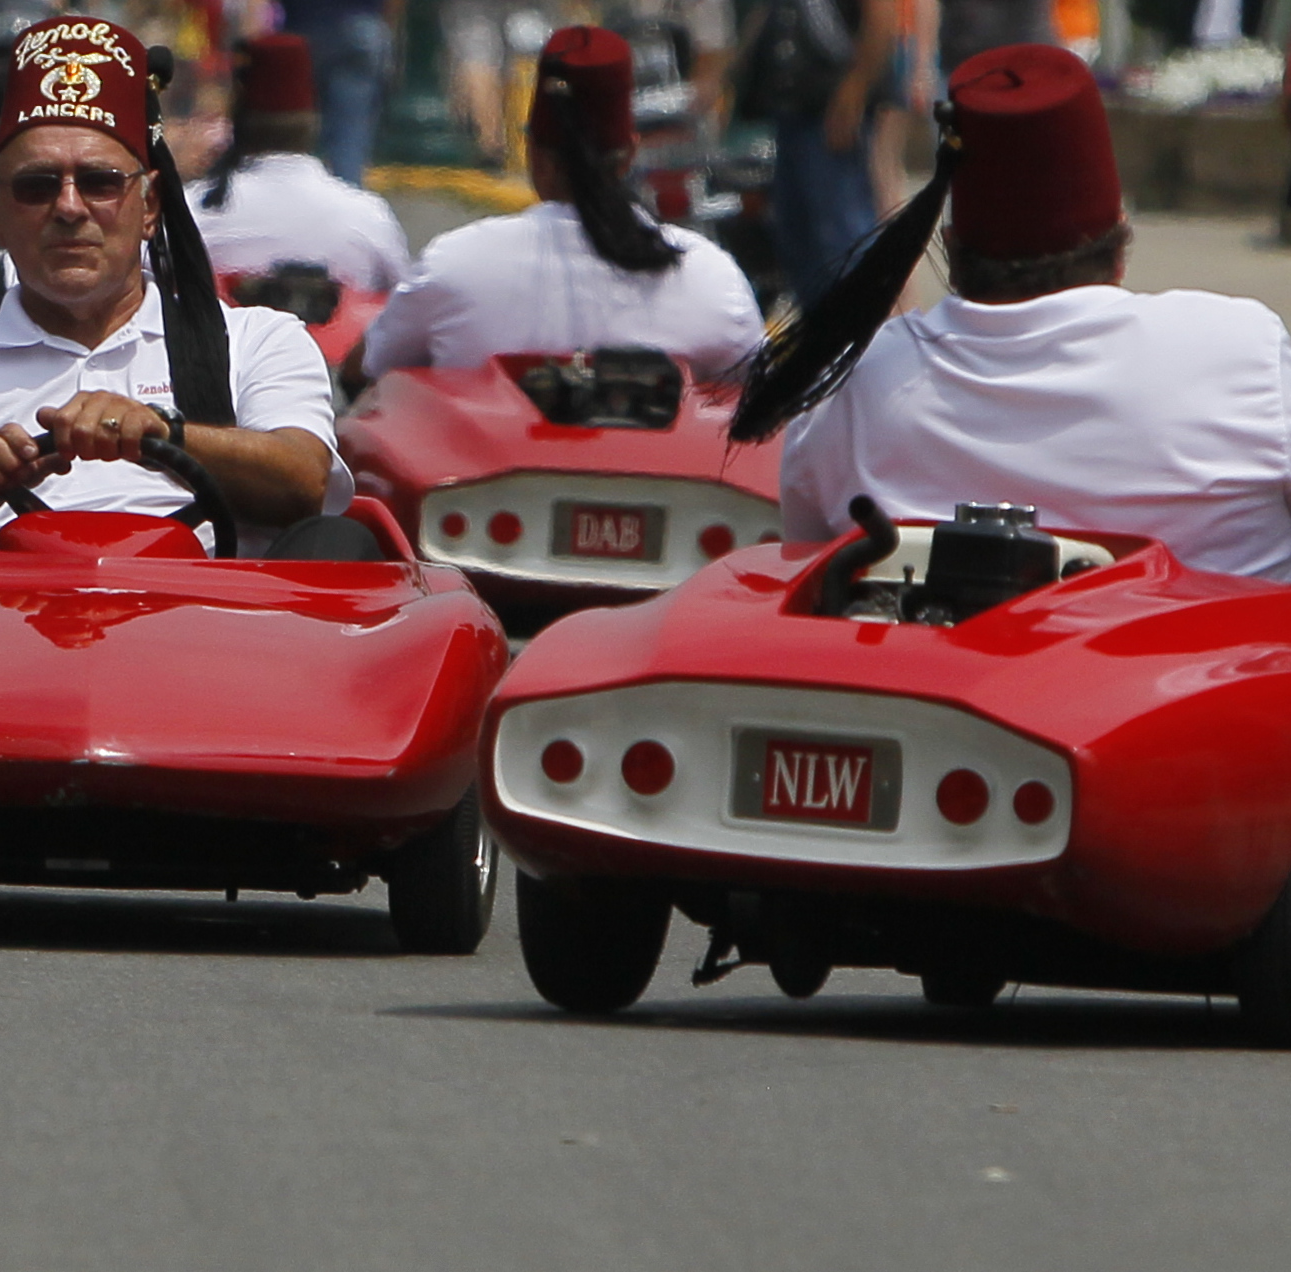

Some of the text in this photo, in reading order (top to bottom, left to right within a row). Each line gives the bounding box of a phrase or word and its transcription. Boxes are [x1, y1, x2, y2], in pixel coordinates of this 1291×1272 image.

[15, 23, 135, 77] Zenobia
[18, 103, 116, 127] LANCERS
[577, 513, 641, 552] DAB
[769, 750, 867, 811] NLW
